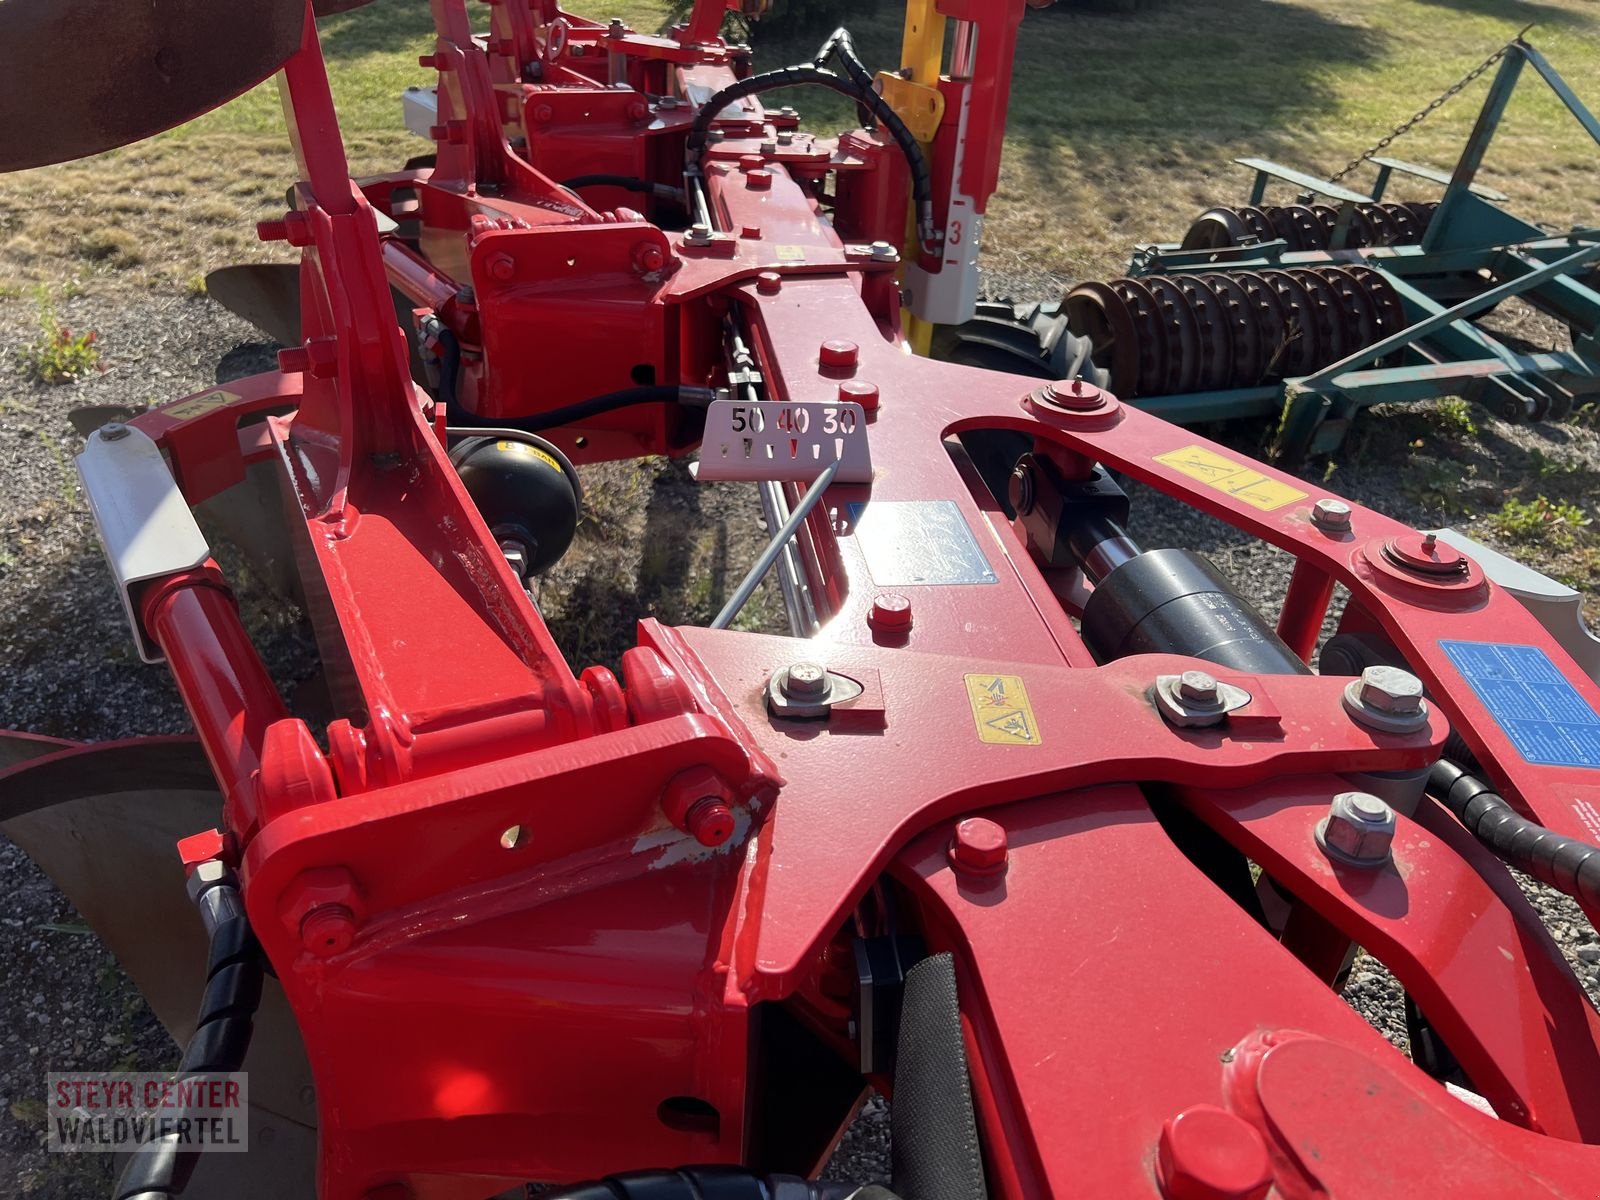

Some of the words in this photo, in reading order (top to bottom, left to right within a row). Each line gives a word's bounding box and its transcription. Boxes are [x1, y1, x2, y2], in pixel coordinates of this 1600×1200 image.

[949, 221, 962, 245] 3
[732, 407, 765, 433] 50
[776, 408, 810, 434] 40
[823, 408, 856, 434] 30
